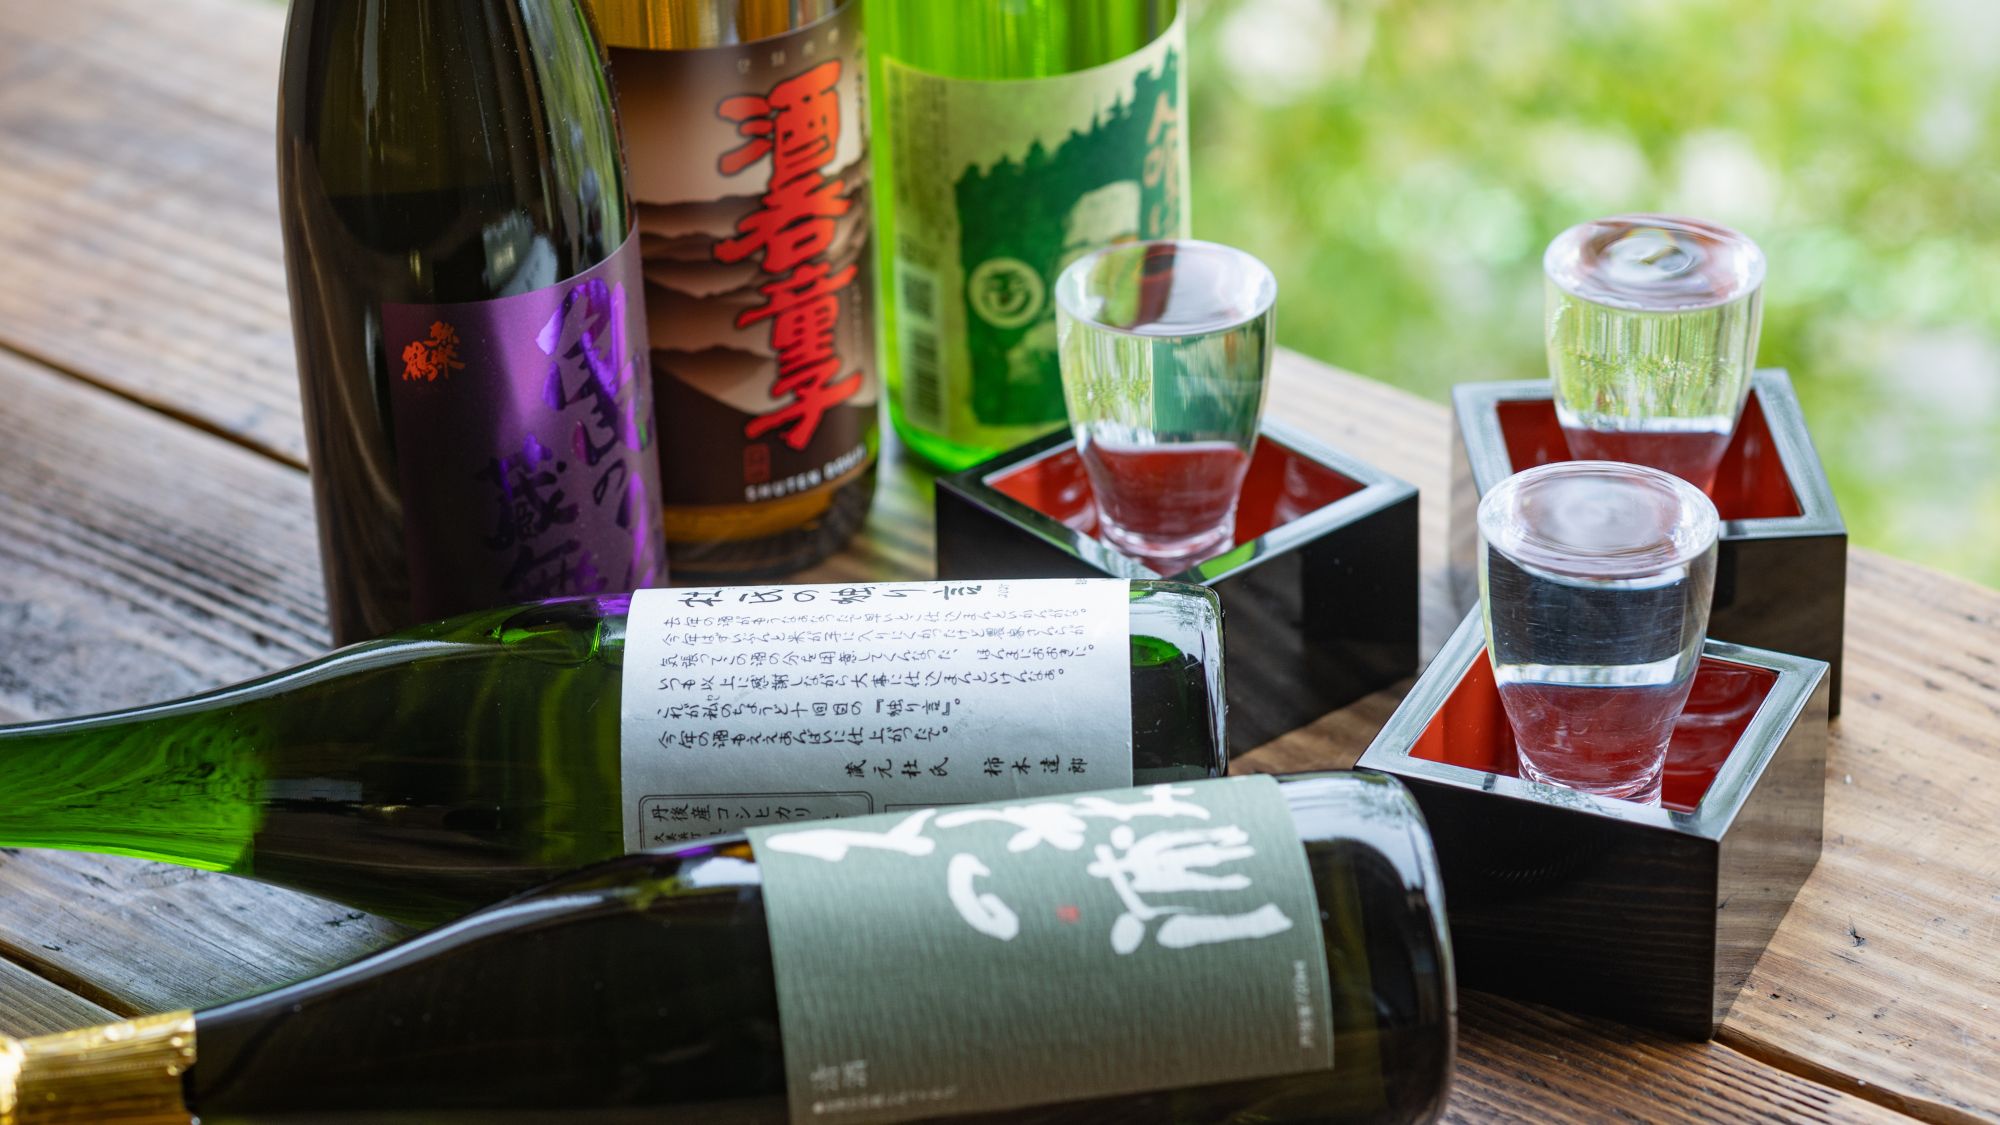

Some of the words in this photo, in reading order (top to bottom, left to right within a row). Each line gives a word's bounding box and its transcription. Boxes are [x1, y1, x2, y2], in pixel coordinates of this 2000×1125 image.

[744, 468, 822, 502] SHUTEN
[678, 585, 982, 607] 杜氏の独り言
[845, 757, 950, 778] 蔵元杜氏
[653, 803, 811, 822] 丹後産コシヒカリ
